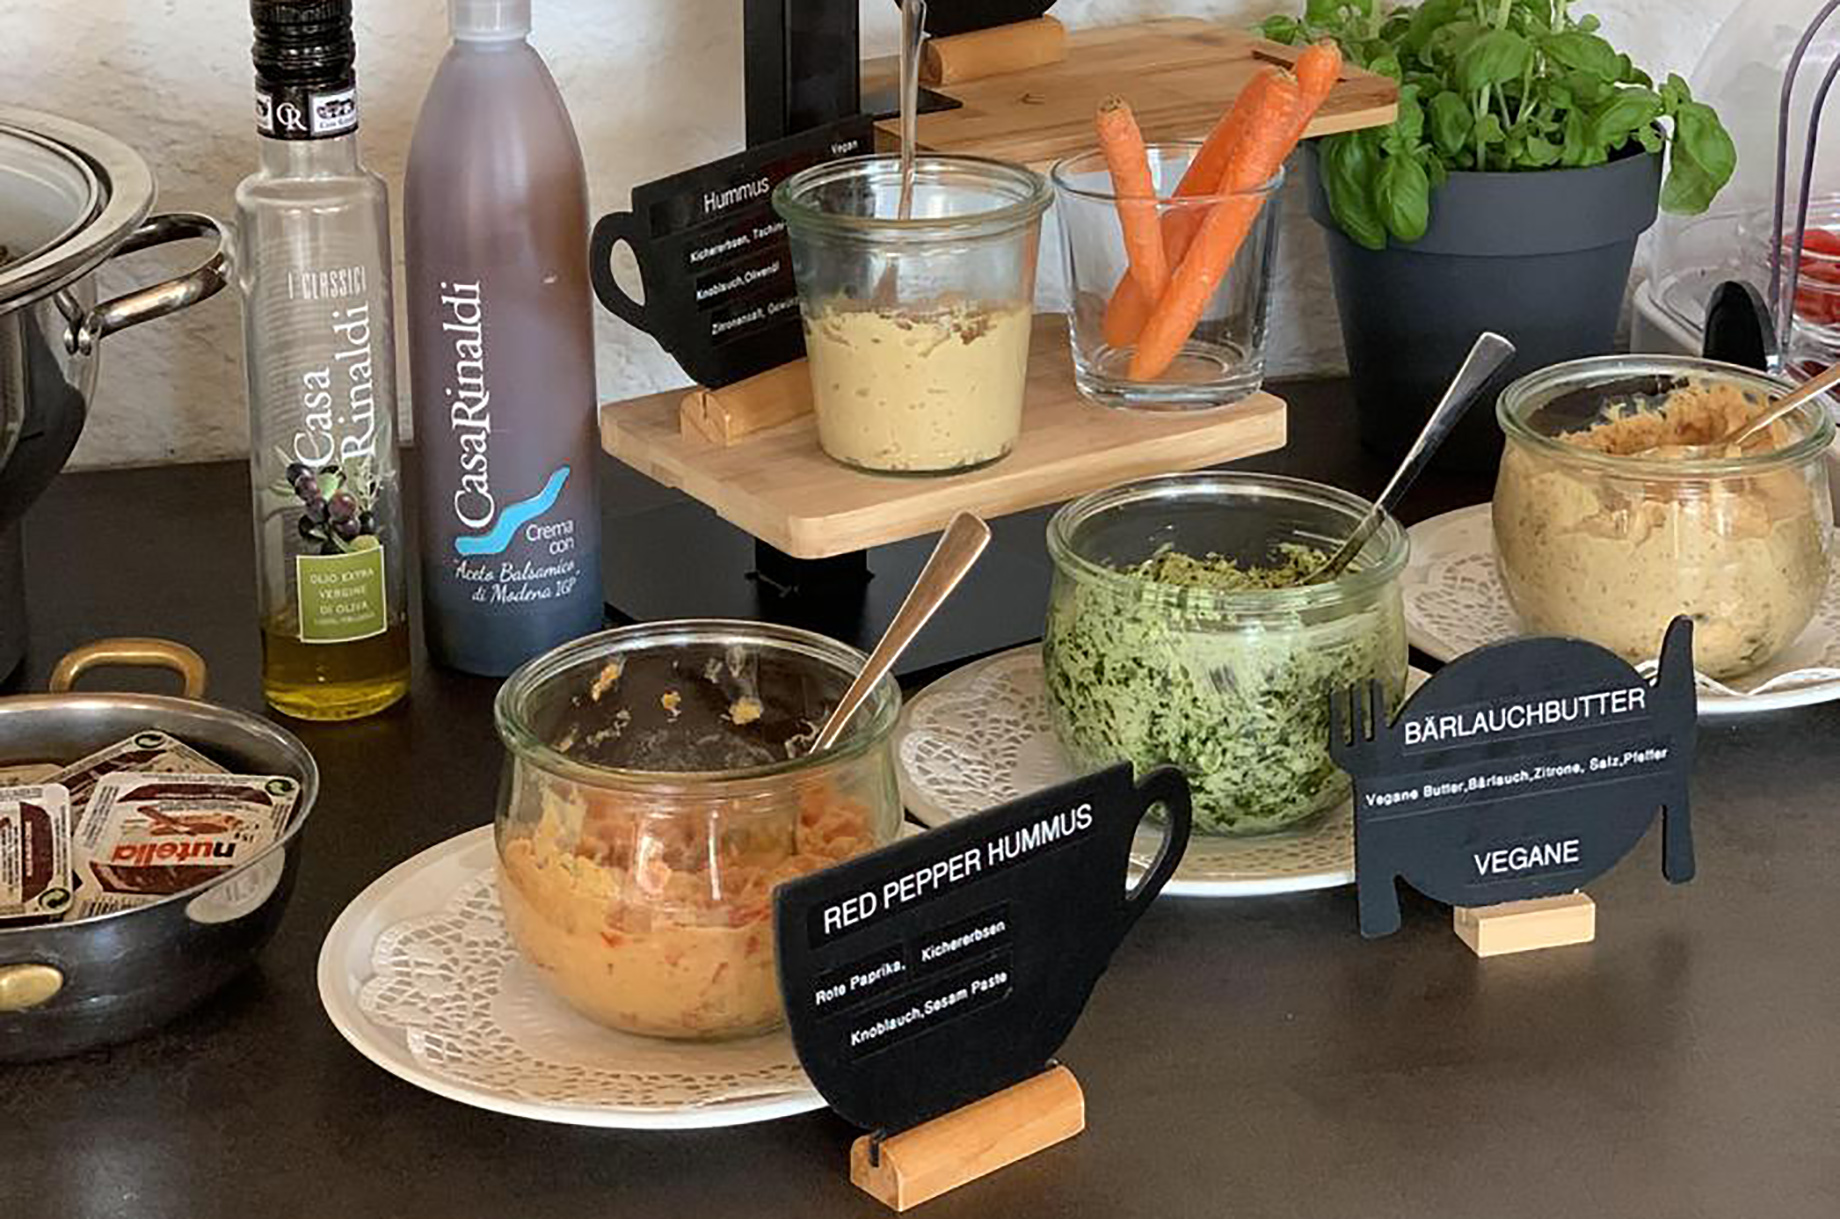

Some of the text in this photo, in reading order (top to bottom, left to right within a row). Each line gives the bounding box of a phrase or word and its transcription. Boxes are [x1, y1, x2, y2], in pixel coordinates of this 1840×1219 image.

[831, 140, 858, 155] Vegan
[704, 177, 770, 213] Hummus
[332, 300, 376, 463] Rinaldi
[294, 367, 334, 468] Casa
[526, 520, 574, 541] Crema
[549, 537, 574, 555] con
[472, 586, 486, 601] di
[490, 583, 552, 604] Modena
[1404, 687, 1646, 745] BÄRLAUCHBUTTER
[1365, 789, 1419, 806] Vegane
[111, 840, 236, 868] nutella
[823, 803, 1094, 934] RED PEPPER HUMMUS
[1474, 839, 1580, 875] VEGANE
[815, 981, 847, 1005] Rote
[921, 919, 1006, 962] Kichererbsen
[971, 969, 1008, 995] Paste
